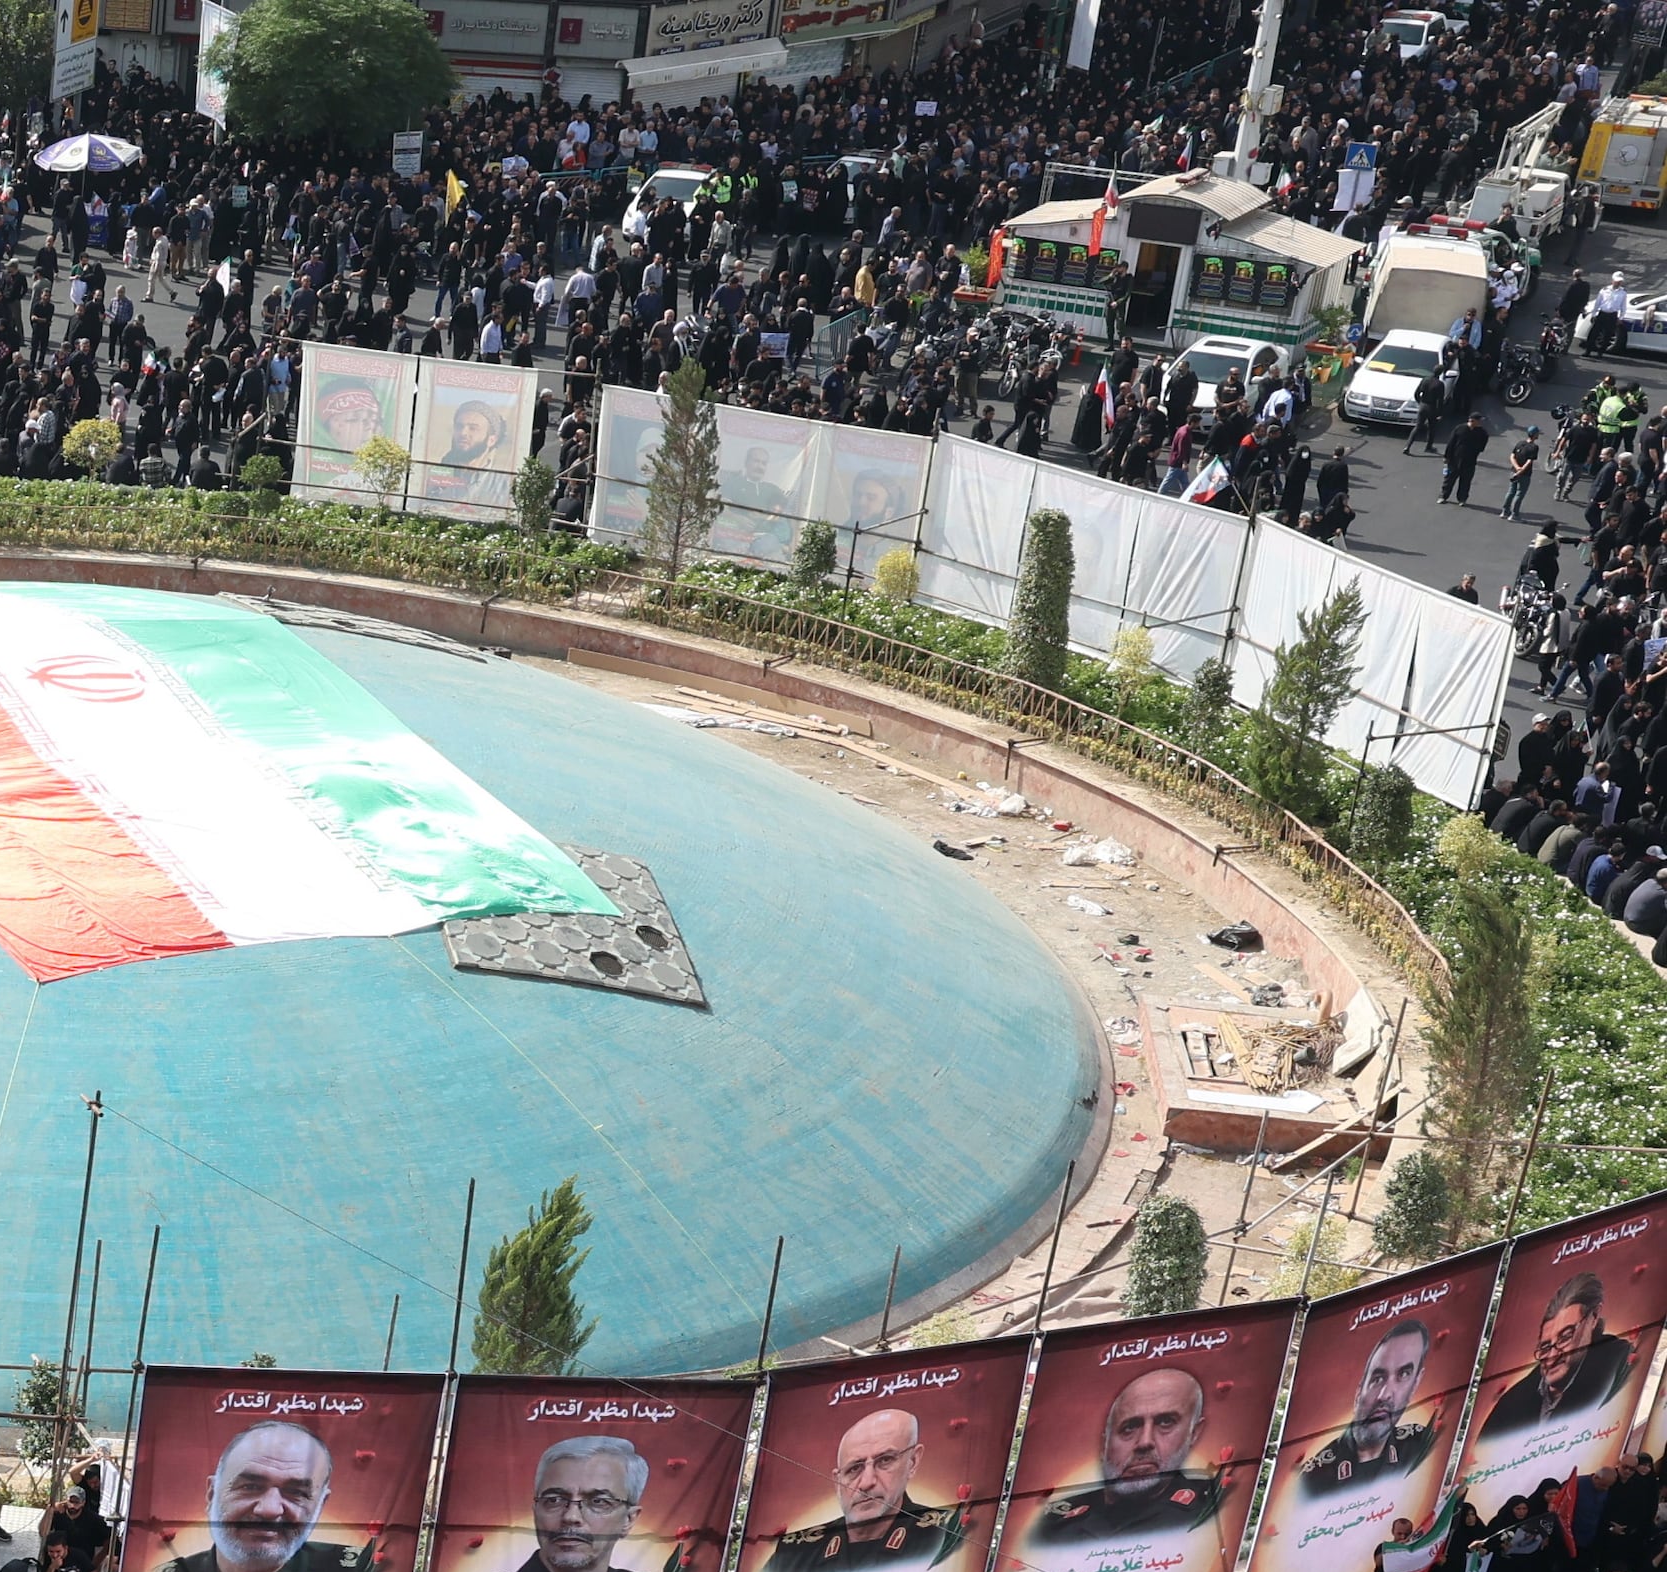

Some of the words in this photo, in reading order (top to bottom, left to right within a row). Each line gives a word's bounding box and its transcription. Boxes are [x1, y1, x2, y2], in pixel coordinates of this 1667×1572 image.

[660, 11, 731, 42] ویتامینه
[1618, 1218, 1649, 1240] شهدا
[1552, 1238, 1589, 1264] اقتدار
[1588, 1230, 1619, 1254] مظهر
[1420, 1282, 1449, 1303] شهدا
[1388, 1292, 1419, 1317] مظهر
[1349, 1302, 1387, 1331] اقتدار
[1099, 1340, 1148, 1366] اقتدار
[1149, 1337, 1187, 1360] مظهر
[1189, 1331, 1228, 1353] شهدا
[880, 1374, 918, 1399] مظهر
[921, 1368, 960, 1391] شهدا
[215, 1392, 271, 1413] اقتدار
[270, 1394, 317, 1415] مظهر
[320, 1396, 364, 1413] شهدا
[828, 1381, 878, 1406] اقتدار
[526, 1399, 583, 1421] اقتدار
[582, 1402, 630, 1422] مظهر
[632, 1403, 676, 1420] شهدا
[1593, 1420, 1621, 1439] شهید
[1565, 1430, 1591, 1452] دکتر
[1508, 1440, 1566, 1469] عبدالحمید
[1366, 1502, 1395, 1522] شهید
[1298, 1524, 1335, 1549] محقق
[1335, 1513, 1366, 1538] حسن
[1145, 1553, 1184, 1570] شهید
